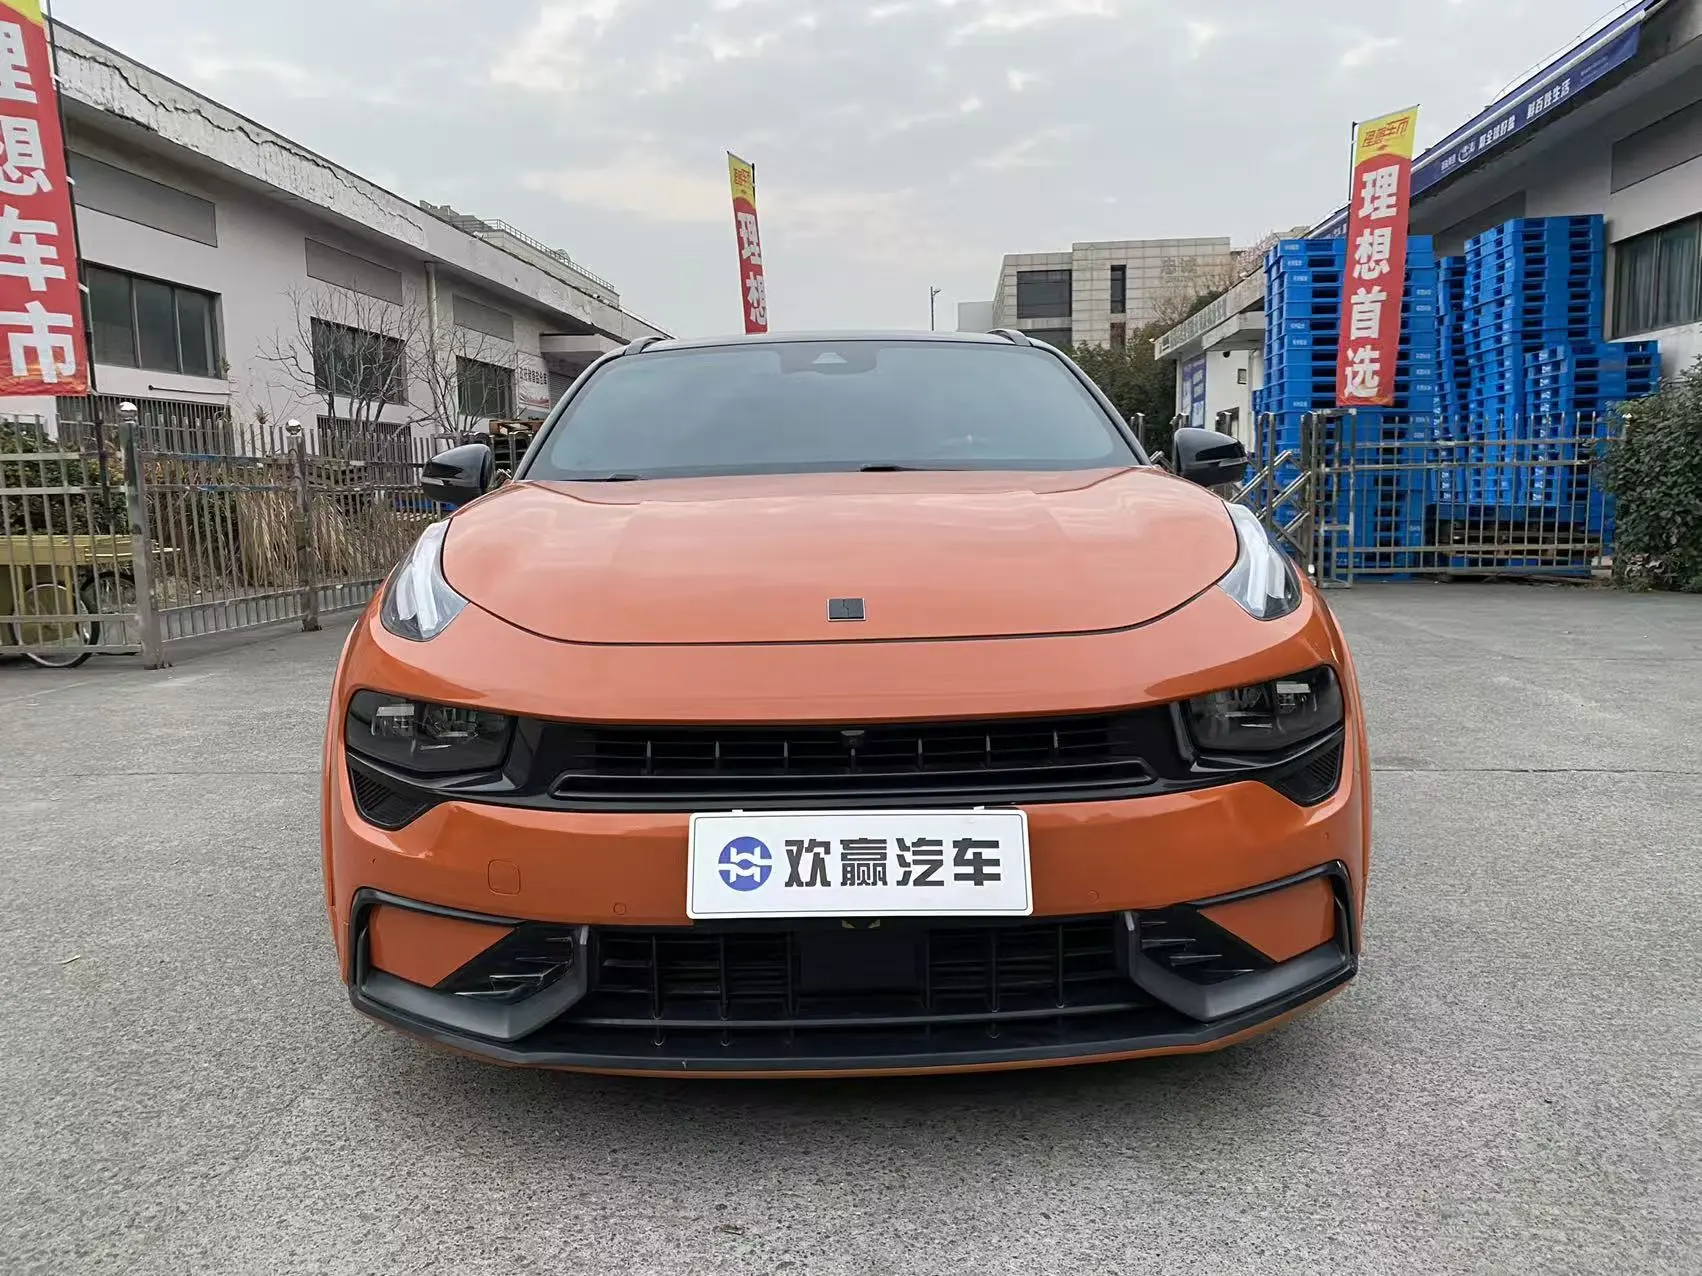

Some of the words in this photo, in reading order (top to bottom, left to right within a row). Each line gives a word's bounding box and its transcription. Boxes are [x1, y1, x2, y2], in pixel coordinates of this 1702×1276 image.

[737, 211, 767, 325] 理想
[1344, 164, 1400, 398] 理想首选
[784, 837, 1001, 887] 欢赢汽车
